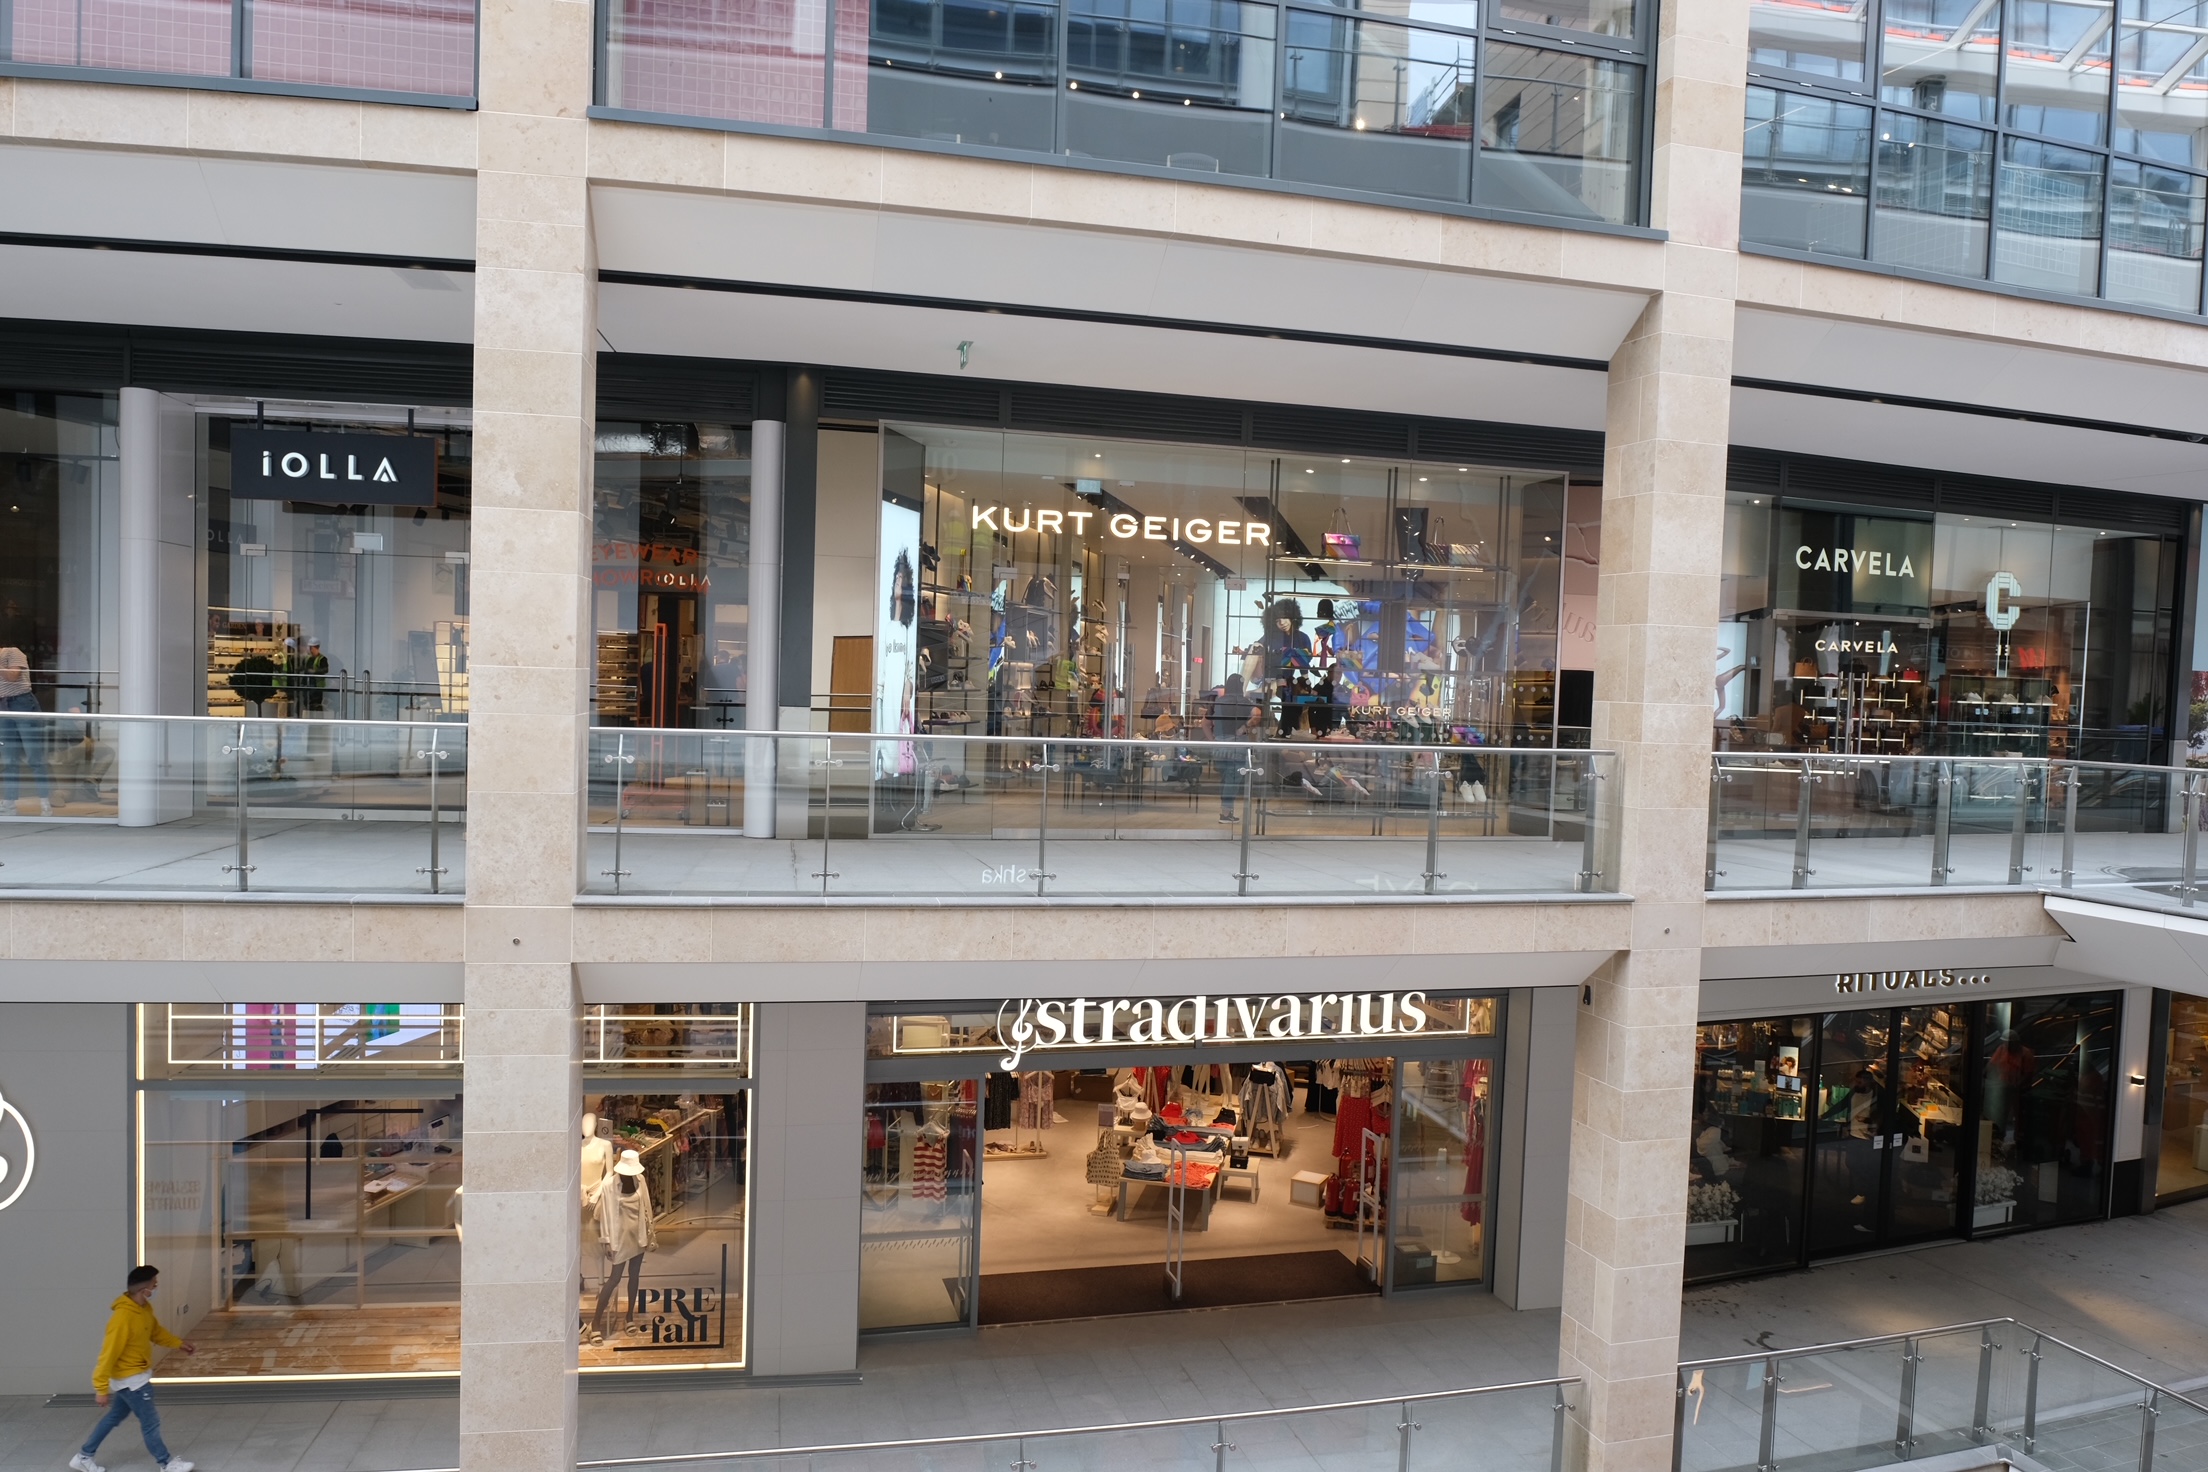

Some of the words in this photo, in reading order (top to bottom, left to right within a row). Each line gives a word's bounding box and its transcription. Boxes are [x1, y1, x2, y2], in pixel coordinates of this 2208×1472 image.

[971, 504, 1094, 536] KURT
[1109, 512, 1272, 547] GEIGER
[1795, 545, 1915, 578] CARVELA
[1814, 639, 1899, 654] CARVELA
[1351, 705, 1392, 716] KURT
[1396, 706, 1453, 718] GEIGER
[1835, 968, 1991, 994] RITUALS...
[1034, 990, 1428, 1046] stradivarius
[637, 1286, 719, 1322] PRE
[639, 1314, 709, 1344] fall
